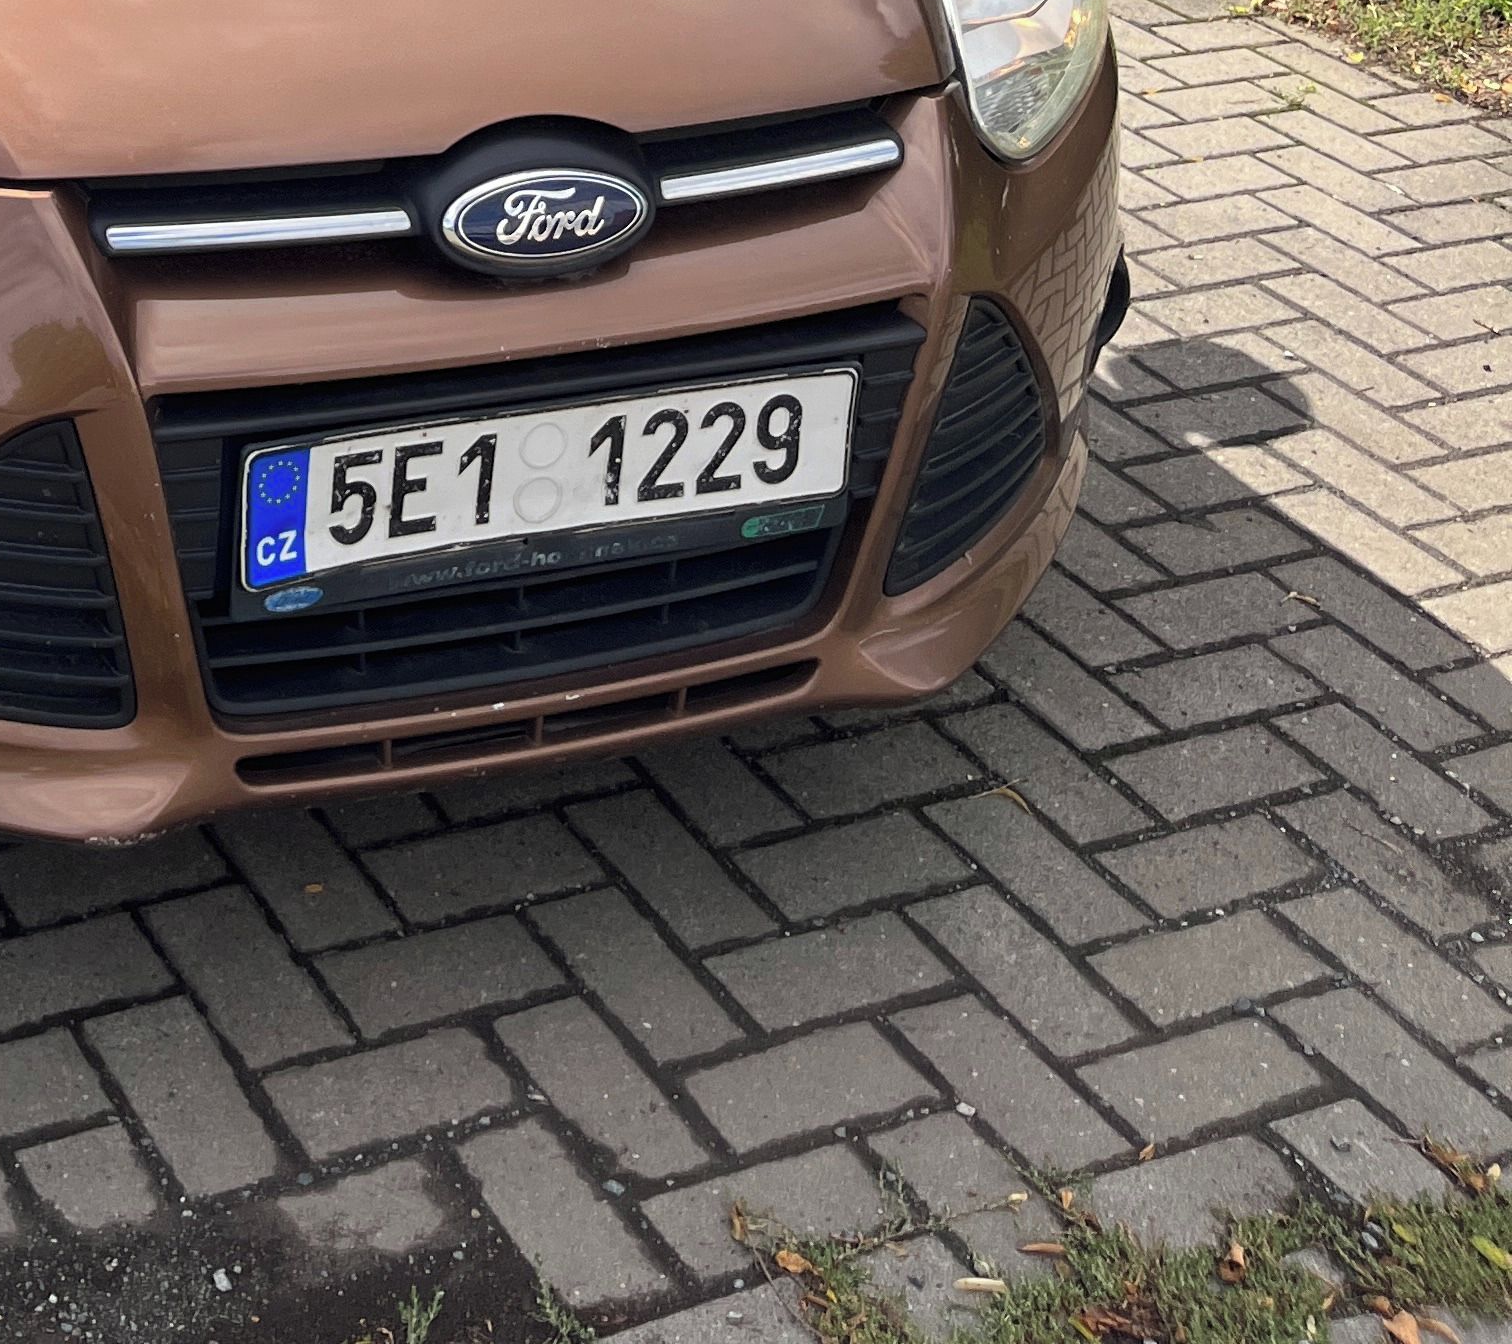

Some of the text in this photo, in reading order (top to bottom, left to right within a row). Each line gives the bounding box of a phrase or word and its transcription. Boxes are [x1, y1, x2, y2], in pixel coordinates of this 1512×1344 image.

[496, 187, 605, 245] Ford
[328, 394, 803, 545] 5E1 1229
[256, 529, 297, 566] CZ
